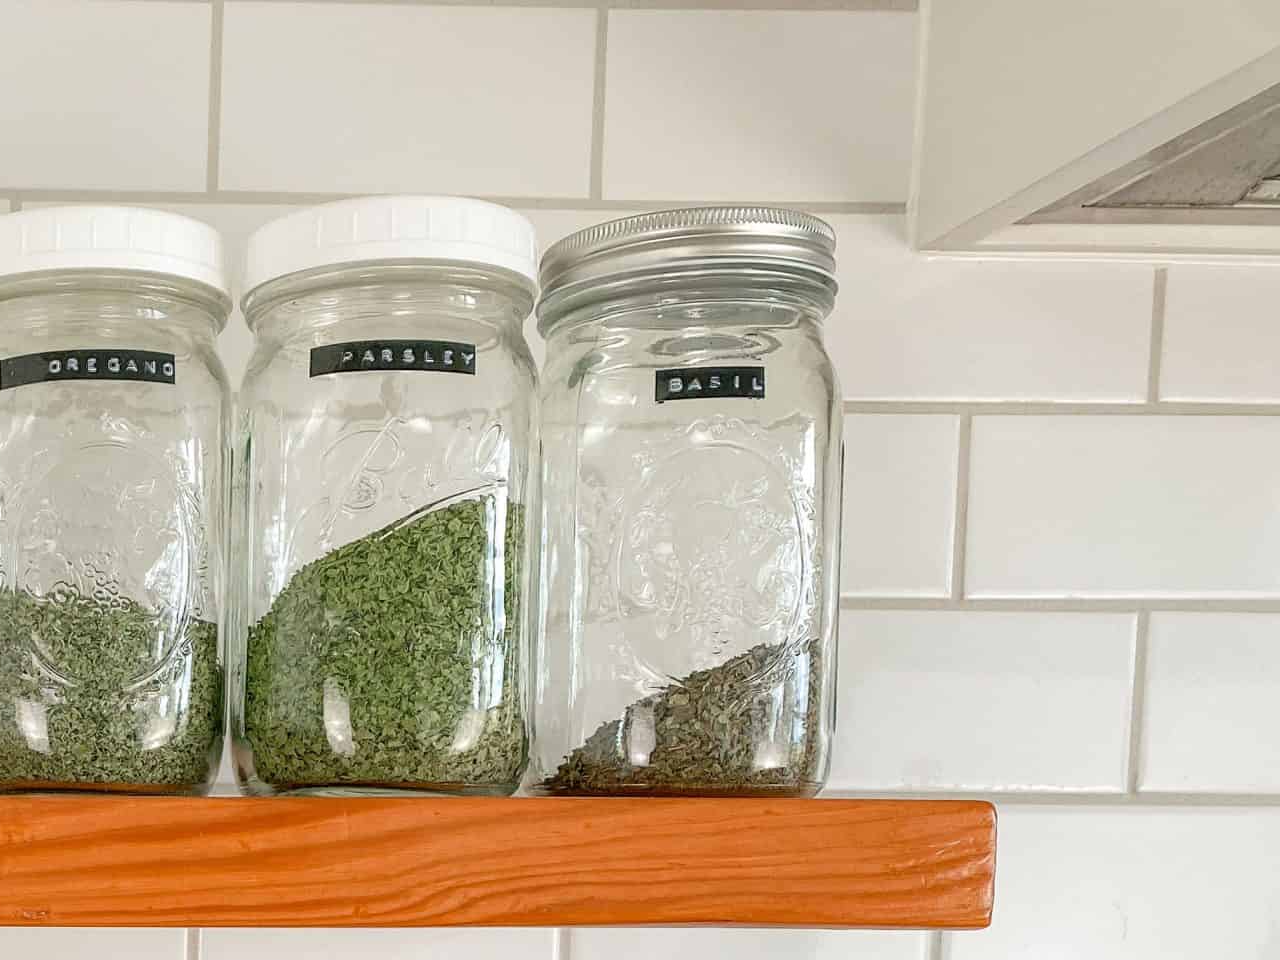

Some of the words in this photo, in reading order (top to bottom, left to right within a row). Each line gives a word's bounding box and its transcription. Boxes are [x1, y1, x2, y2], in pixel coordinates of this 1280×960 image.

[343, 348, 474, 365] PARSLEY
[48, 357, 174, 377] OREGANO
[669, 375, 763, 392] BASIL
